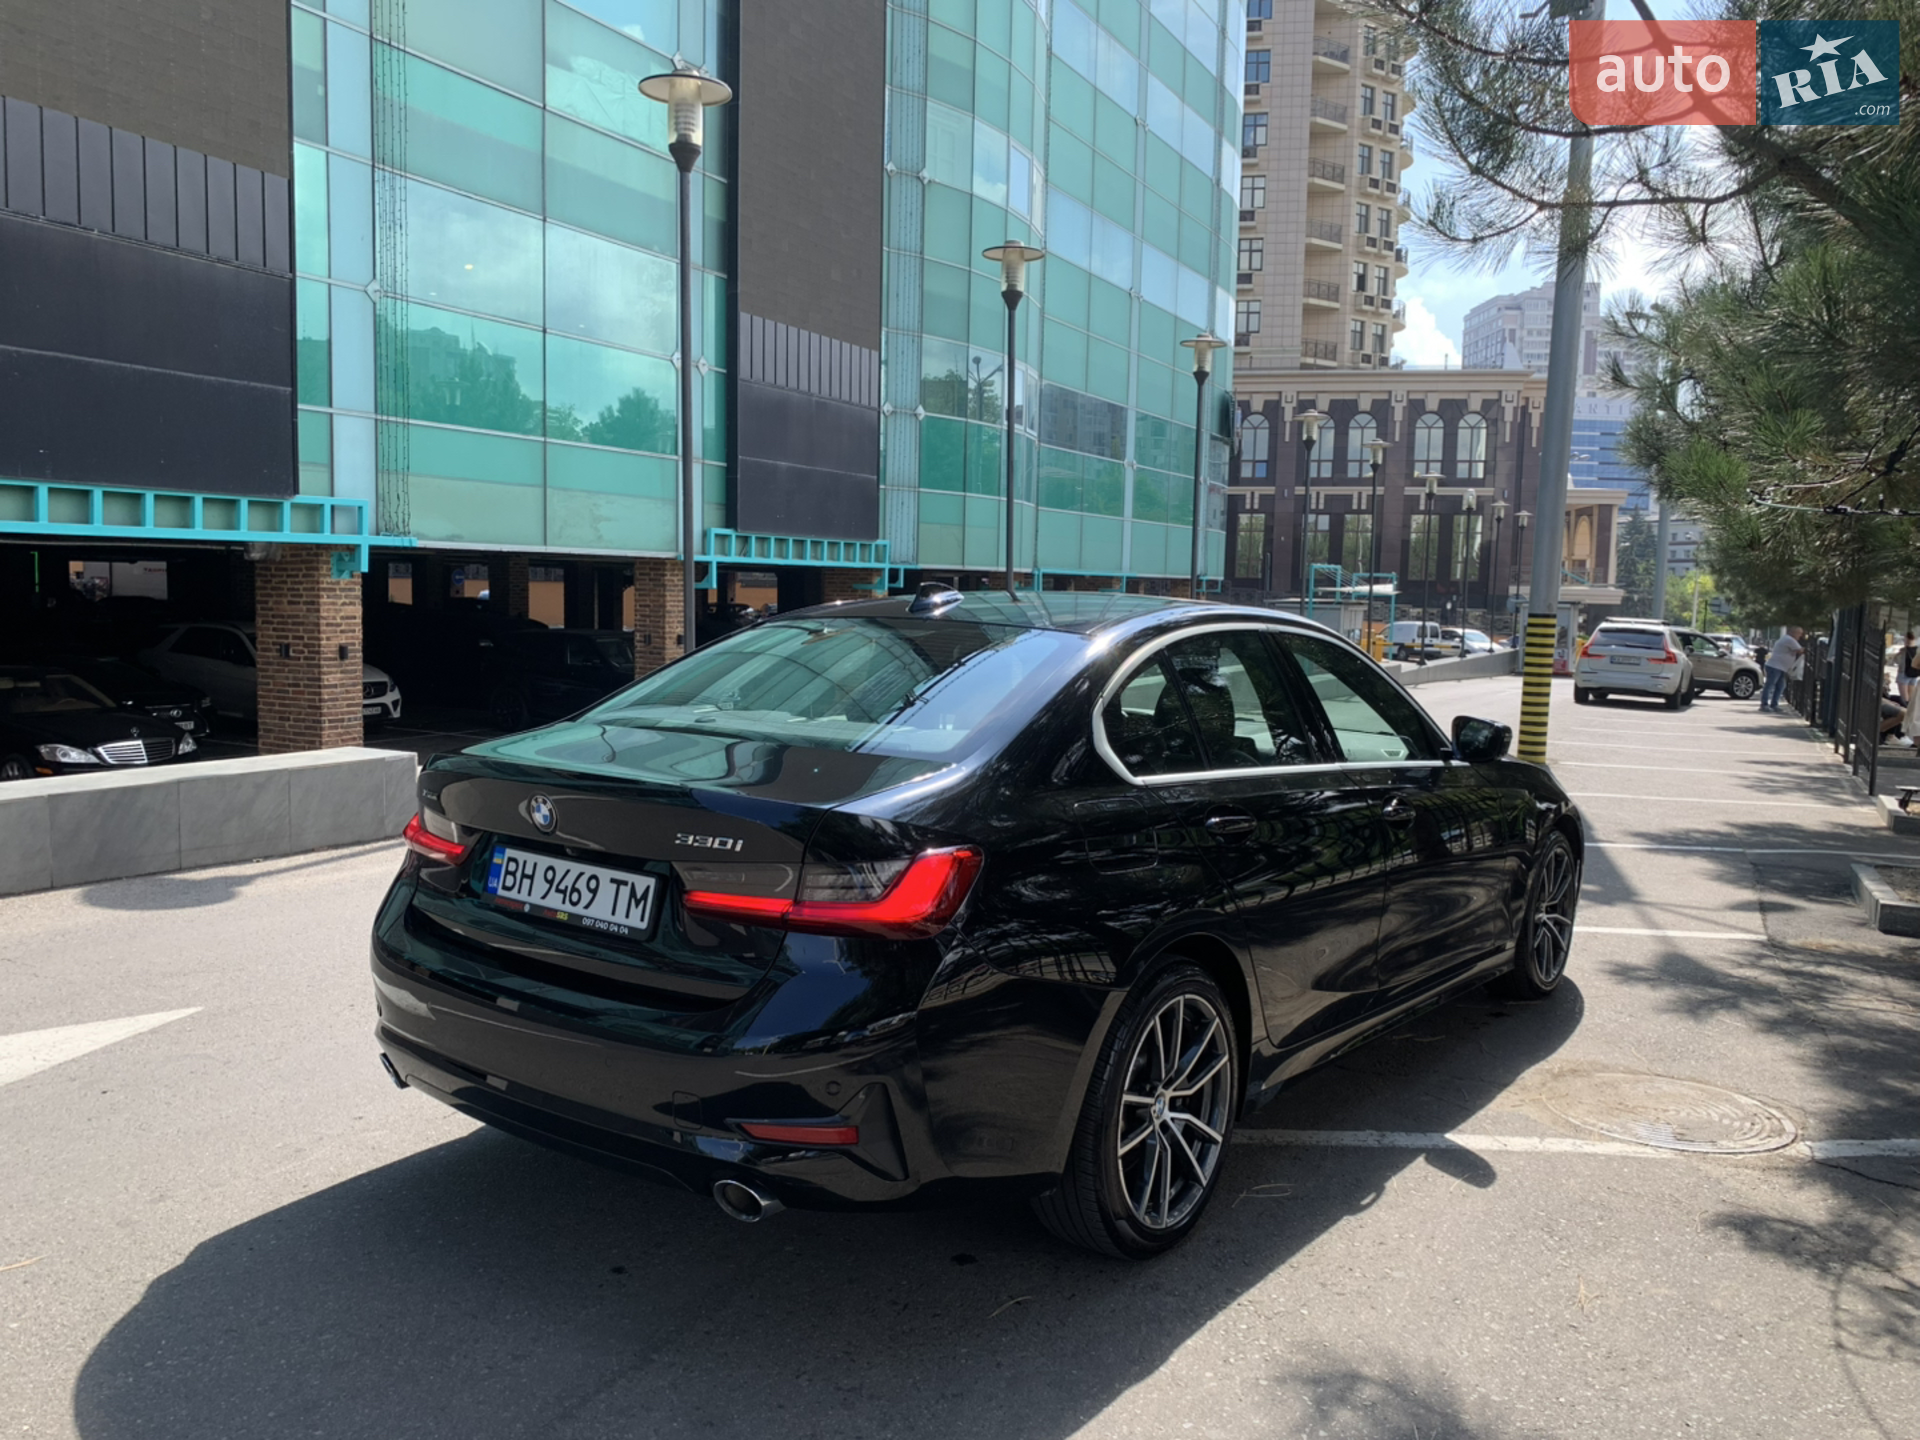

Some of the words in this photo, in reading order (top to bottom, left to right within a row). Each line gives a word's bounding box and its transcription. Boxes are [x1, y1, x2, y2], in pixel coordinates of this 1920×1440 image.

[674, 832, 744, 852] 330i
[487, 877, 499, 889] UA
[501, 857, 538, 897] BH
[540, 865, 600, 910] 9469
[609, 877, 651, 922] TM
